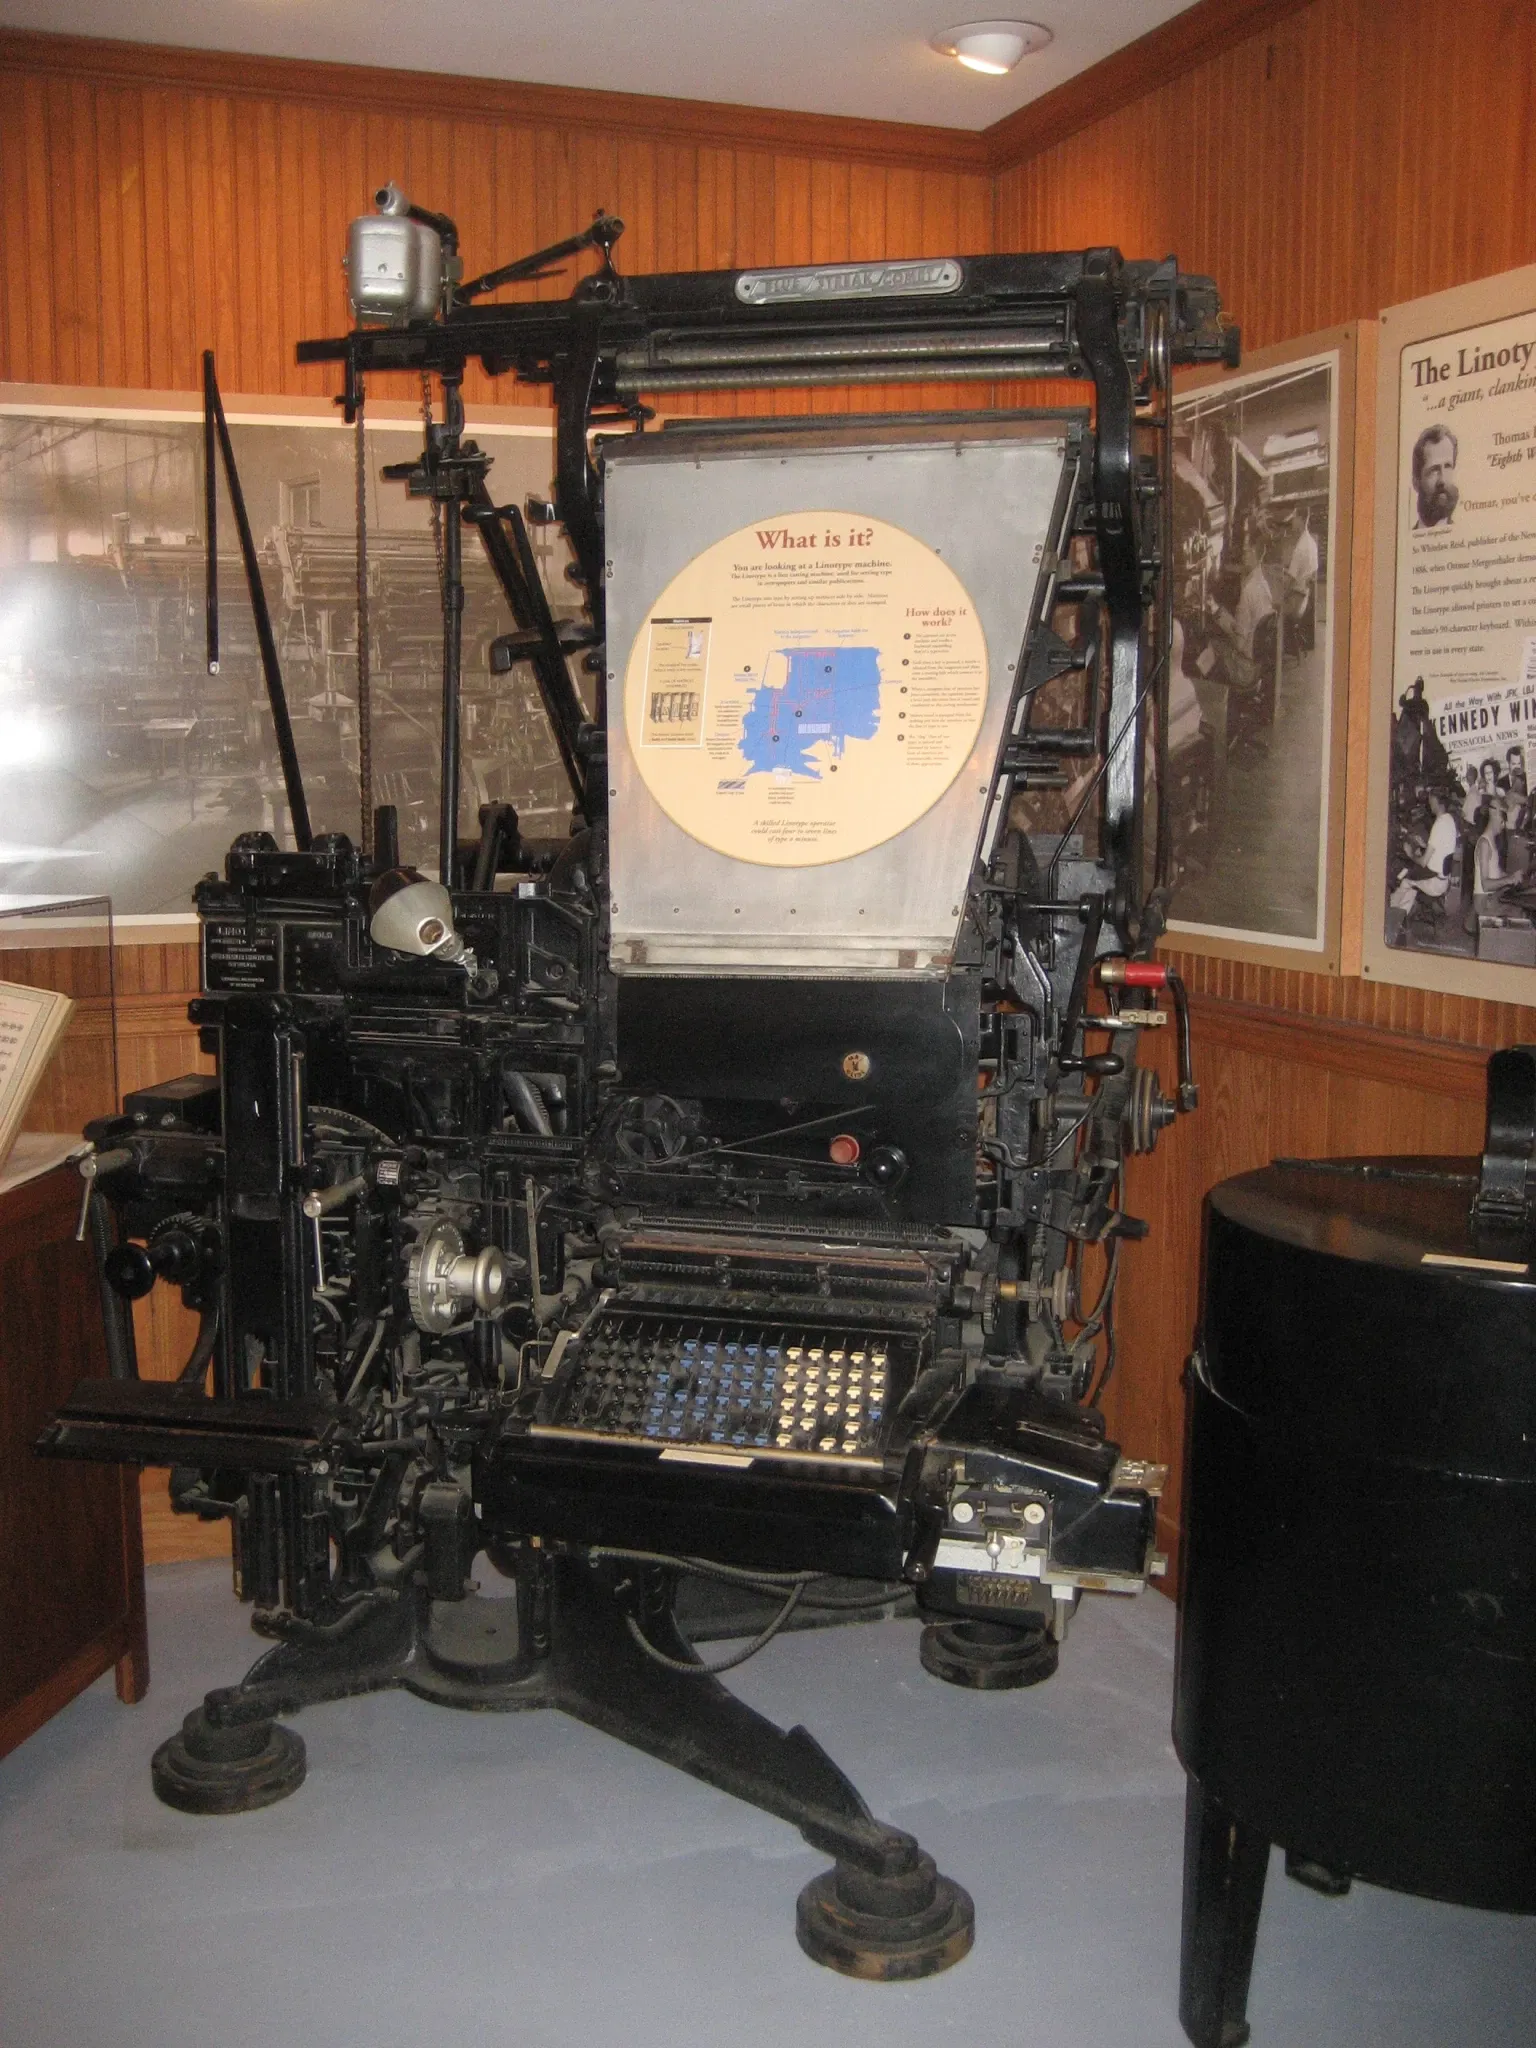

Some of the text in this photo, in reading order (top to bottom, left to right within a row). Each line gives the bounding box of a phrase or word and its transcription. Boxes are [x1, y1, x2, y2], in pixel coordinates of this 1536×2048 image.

[1411, 341, 1536, 387] The Linoty
[1447, 388, 1484, 412] giant,
[1492, 431, 1530, 447] Thomas
[756, 528, 874, 550] What is it?
[1468, 535, 1498, 549] publisher
[1508, 532, 1519, 542] the
[733, 564, 748, 572] You
[750, 564, 762, 572] are
[765, 561, 796, 573] looking
[815, 561, 852, 571] Linotype
[854, 559, 892, 568] machine.
[742, 572, 766, 580] Linotype
[1412, 586, 1422, 596] The
[1424, 584, 1449, 596] Linotype
[1475, 577, 1501, 590] brought
[906, 606, 968, 618] How does it
[1424, 604, 1449, 617] Linotype
[1477, 600, 1501, 612] printers
[922, 617, 953, 627] work?
[1451, 645, 1467, 655] every
[1468, 696, 1484, 706] Way
[1505, 688, 1518, 699] JFK
[1430, 705, 1500, 736] ENNEDY
[1448, 734, 1494, 750] PENSACOLA
[1496, 729, 1519, 741] NEWS
[760, 819, 780, 827] skilled
[781, 819, 808, 828] Linotype
[809, 819, 836, 828] operator
[782, 827, 797, 835] four
[775, 836, 787, 844] type
